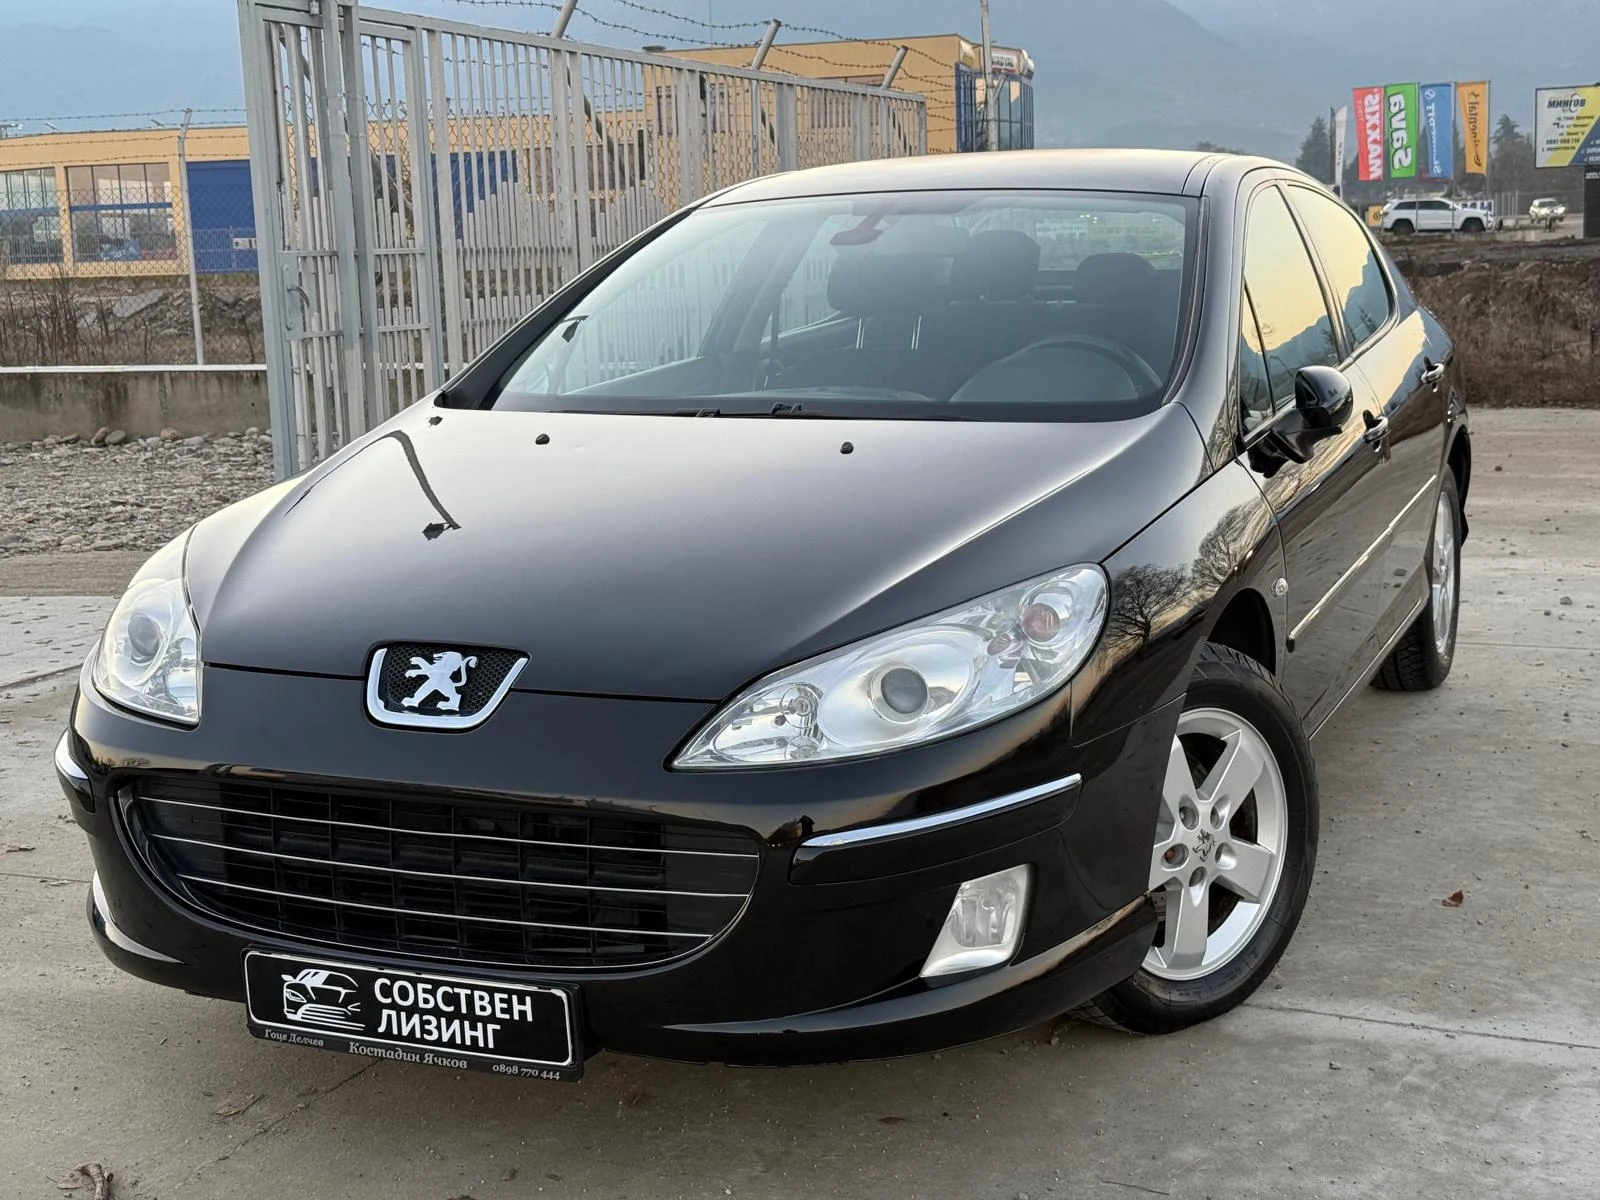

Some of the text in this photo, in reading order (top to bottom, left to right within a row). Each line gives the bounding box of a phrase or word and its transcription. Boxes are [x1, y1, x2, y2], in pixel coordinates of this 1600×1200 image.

[1547, 99, 1586, 109] МИНГОВ
[374, 977, 533, 1022] СОБСТВЕН
[264, 1029, 325, 1048] Гоце Делчев
[377, 1009, 501, 1049] ЛИЗИНГ
[349, 1041, 468, 1070] Костадин Ячков
[492, 1063, 561, 1081] 0898 770 444
